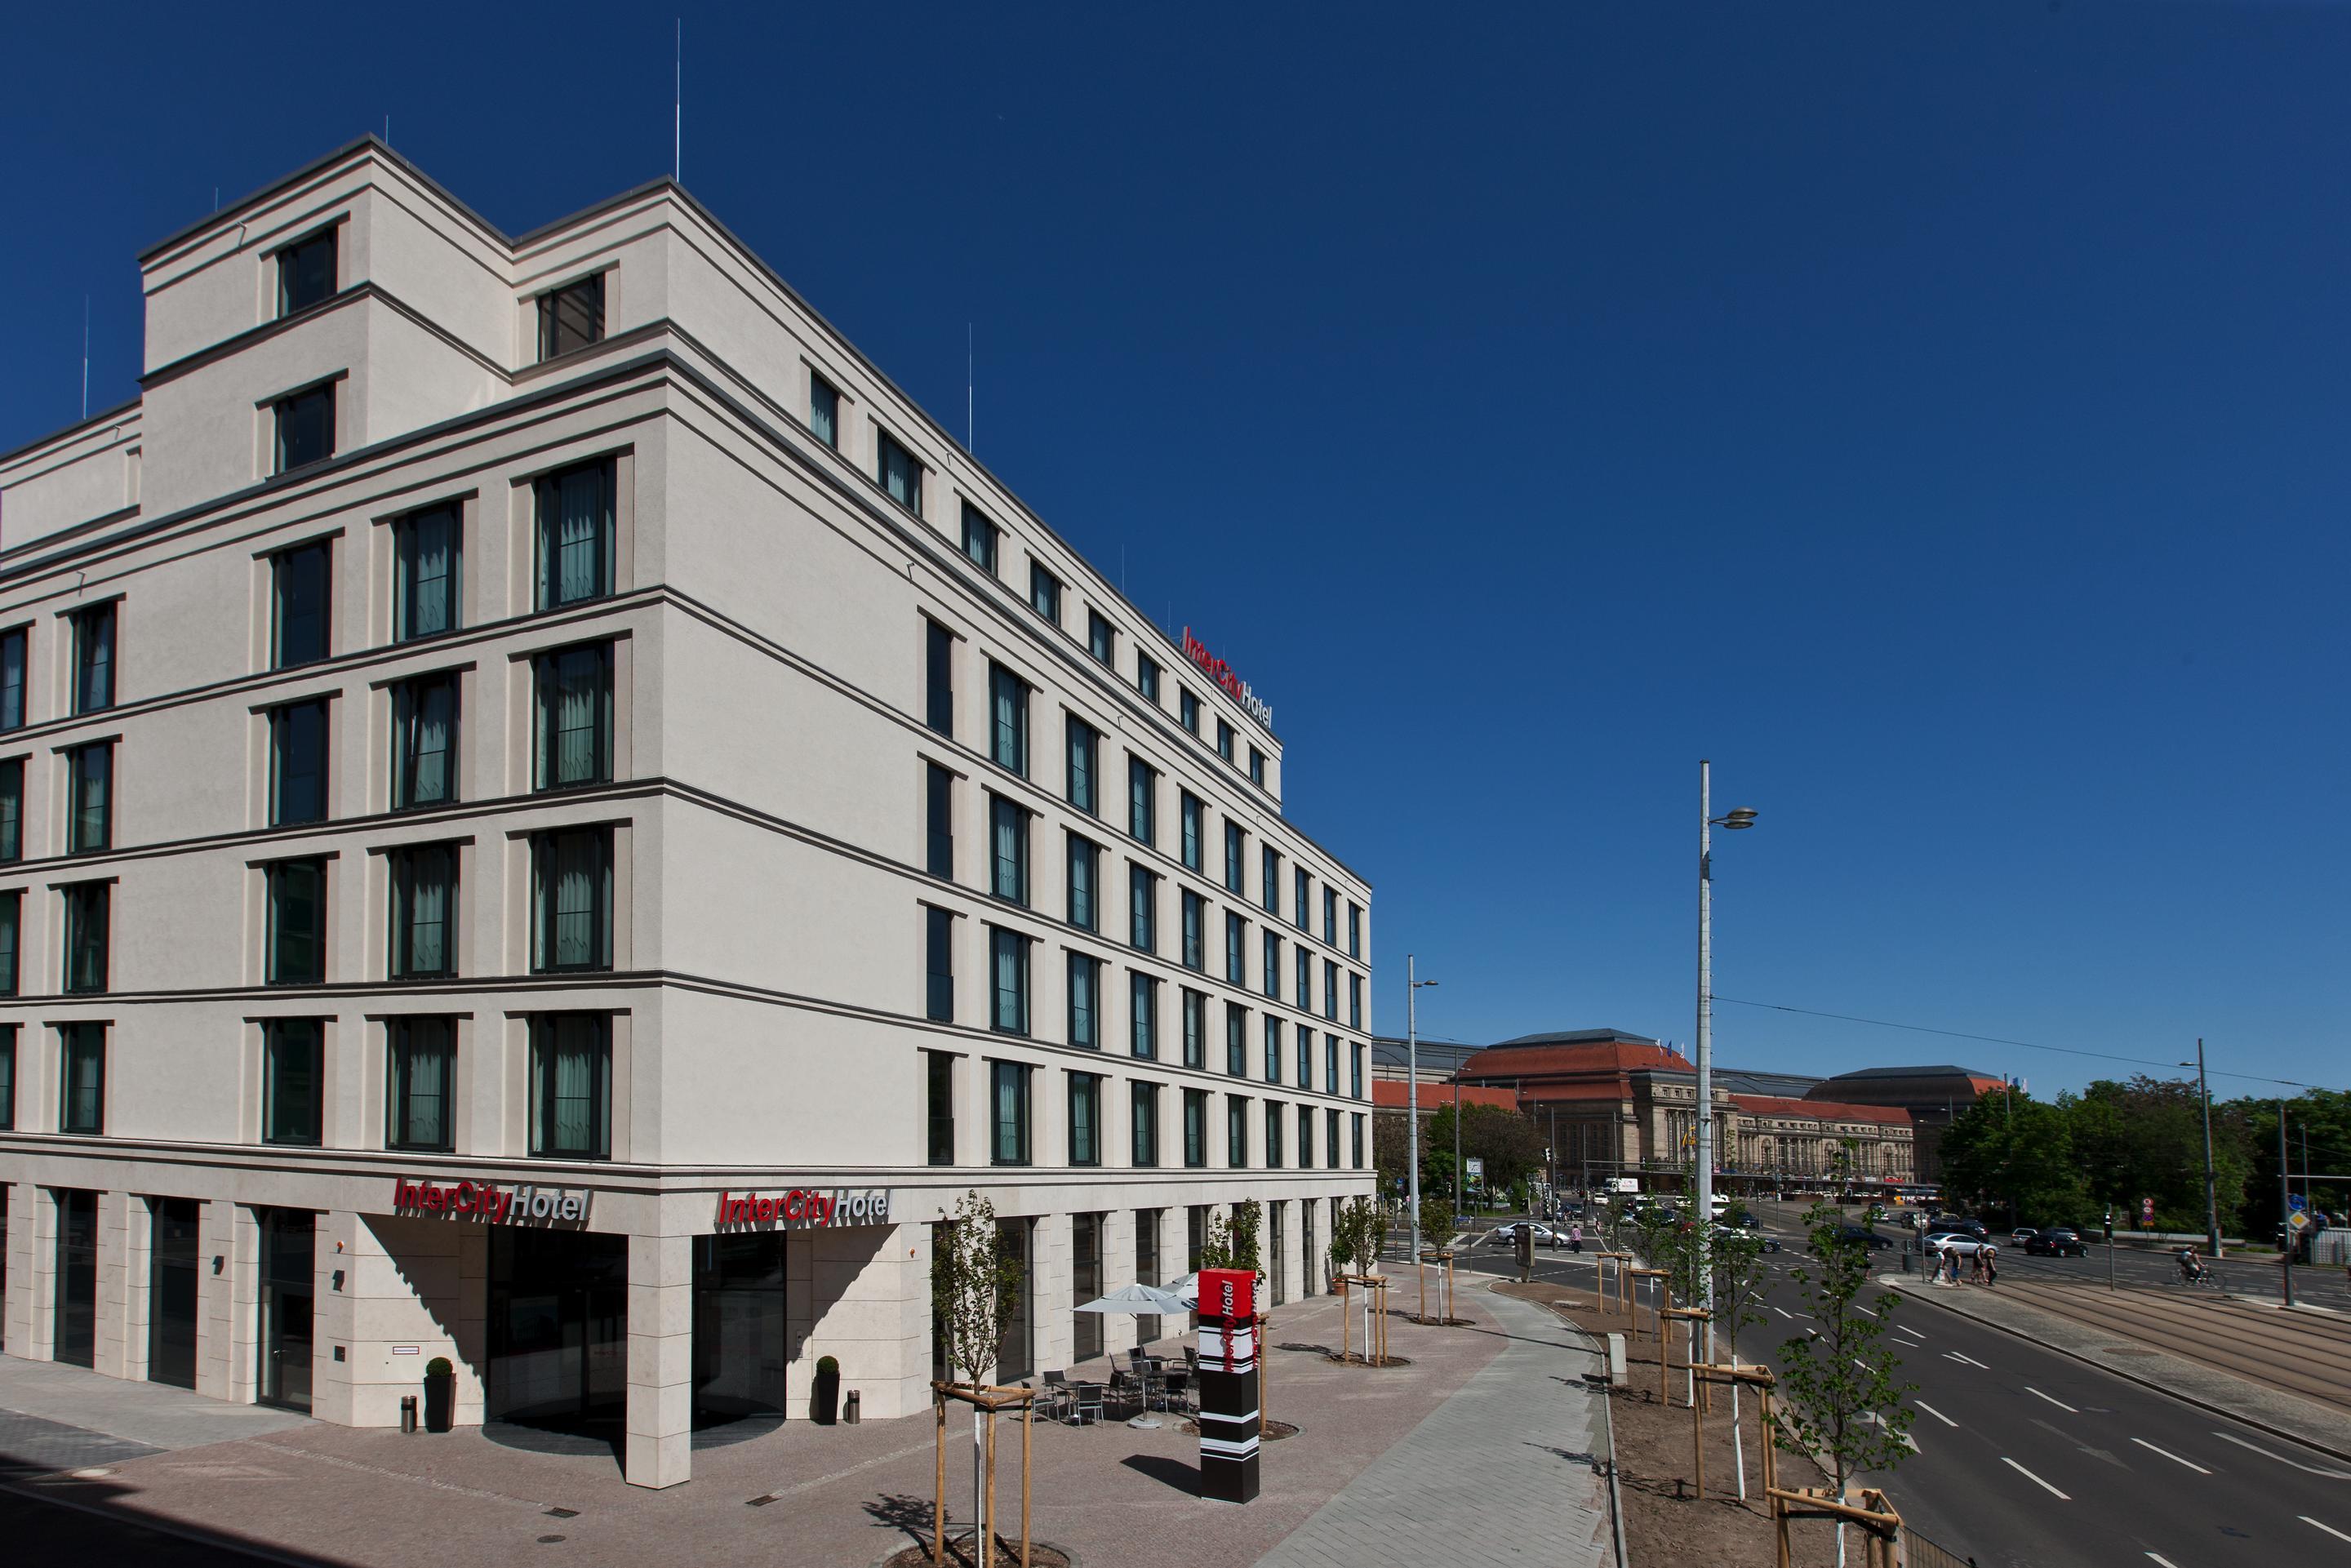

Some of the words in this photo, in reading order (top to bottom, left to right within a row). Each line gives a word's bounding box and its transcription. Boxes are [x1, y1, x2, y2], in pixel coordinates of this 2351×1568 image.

[1183, 626, 1273, 728] InterCityHotel
[393, 1177, 592, 1224] InterCityHotel
[718, 1189, 894, 1226] InterCityHotel
[1222, 1280, 1237, 1372] InterCityHotel
